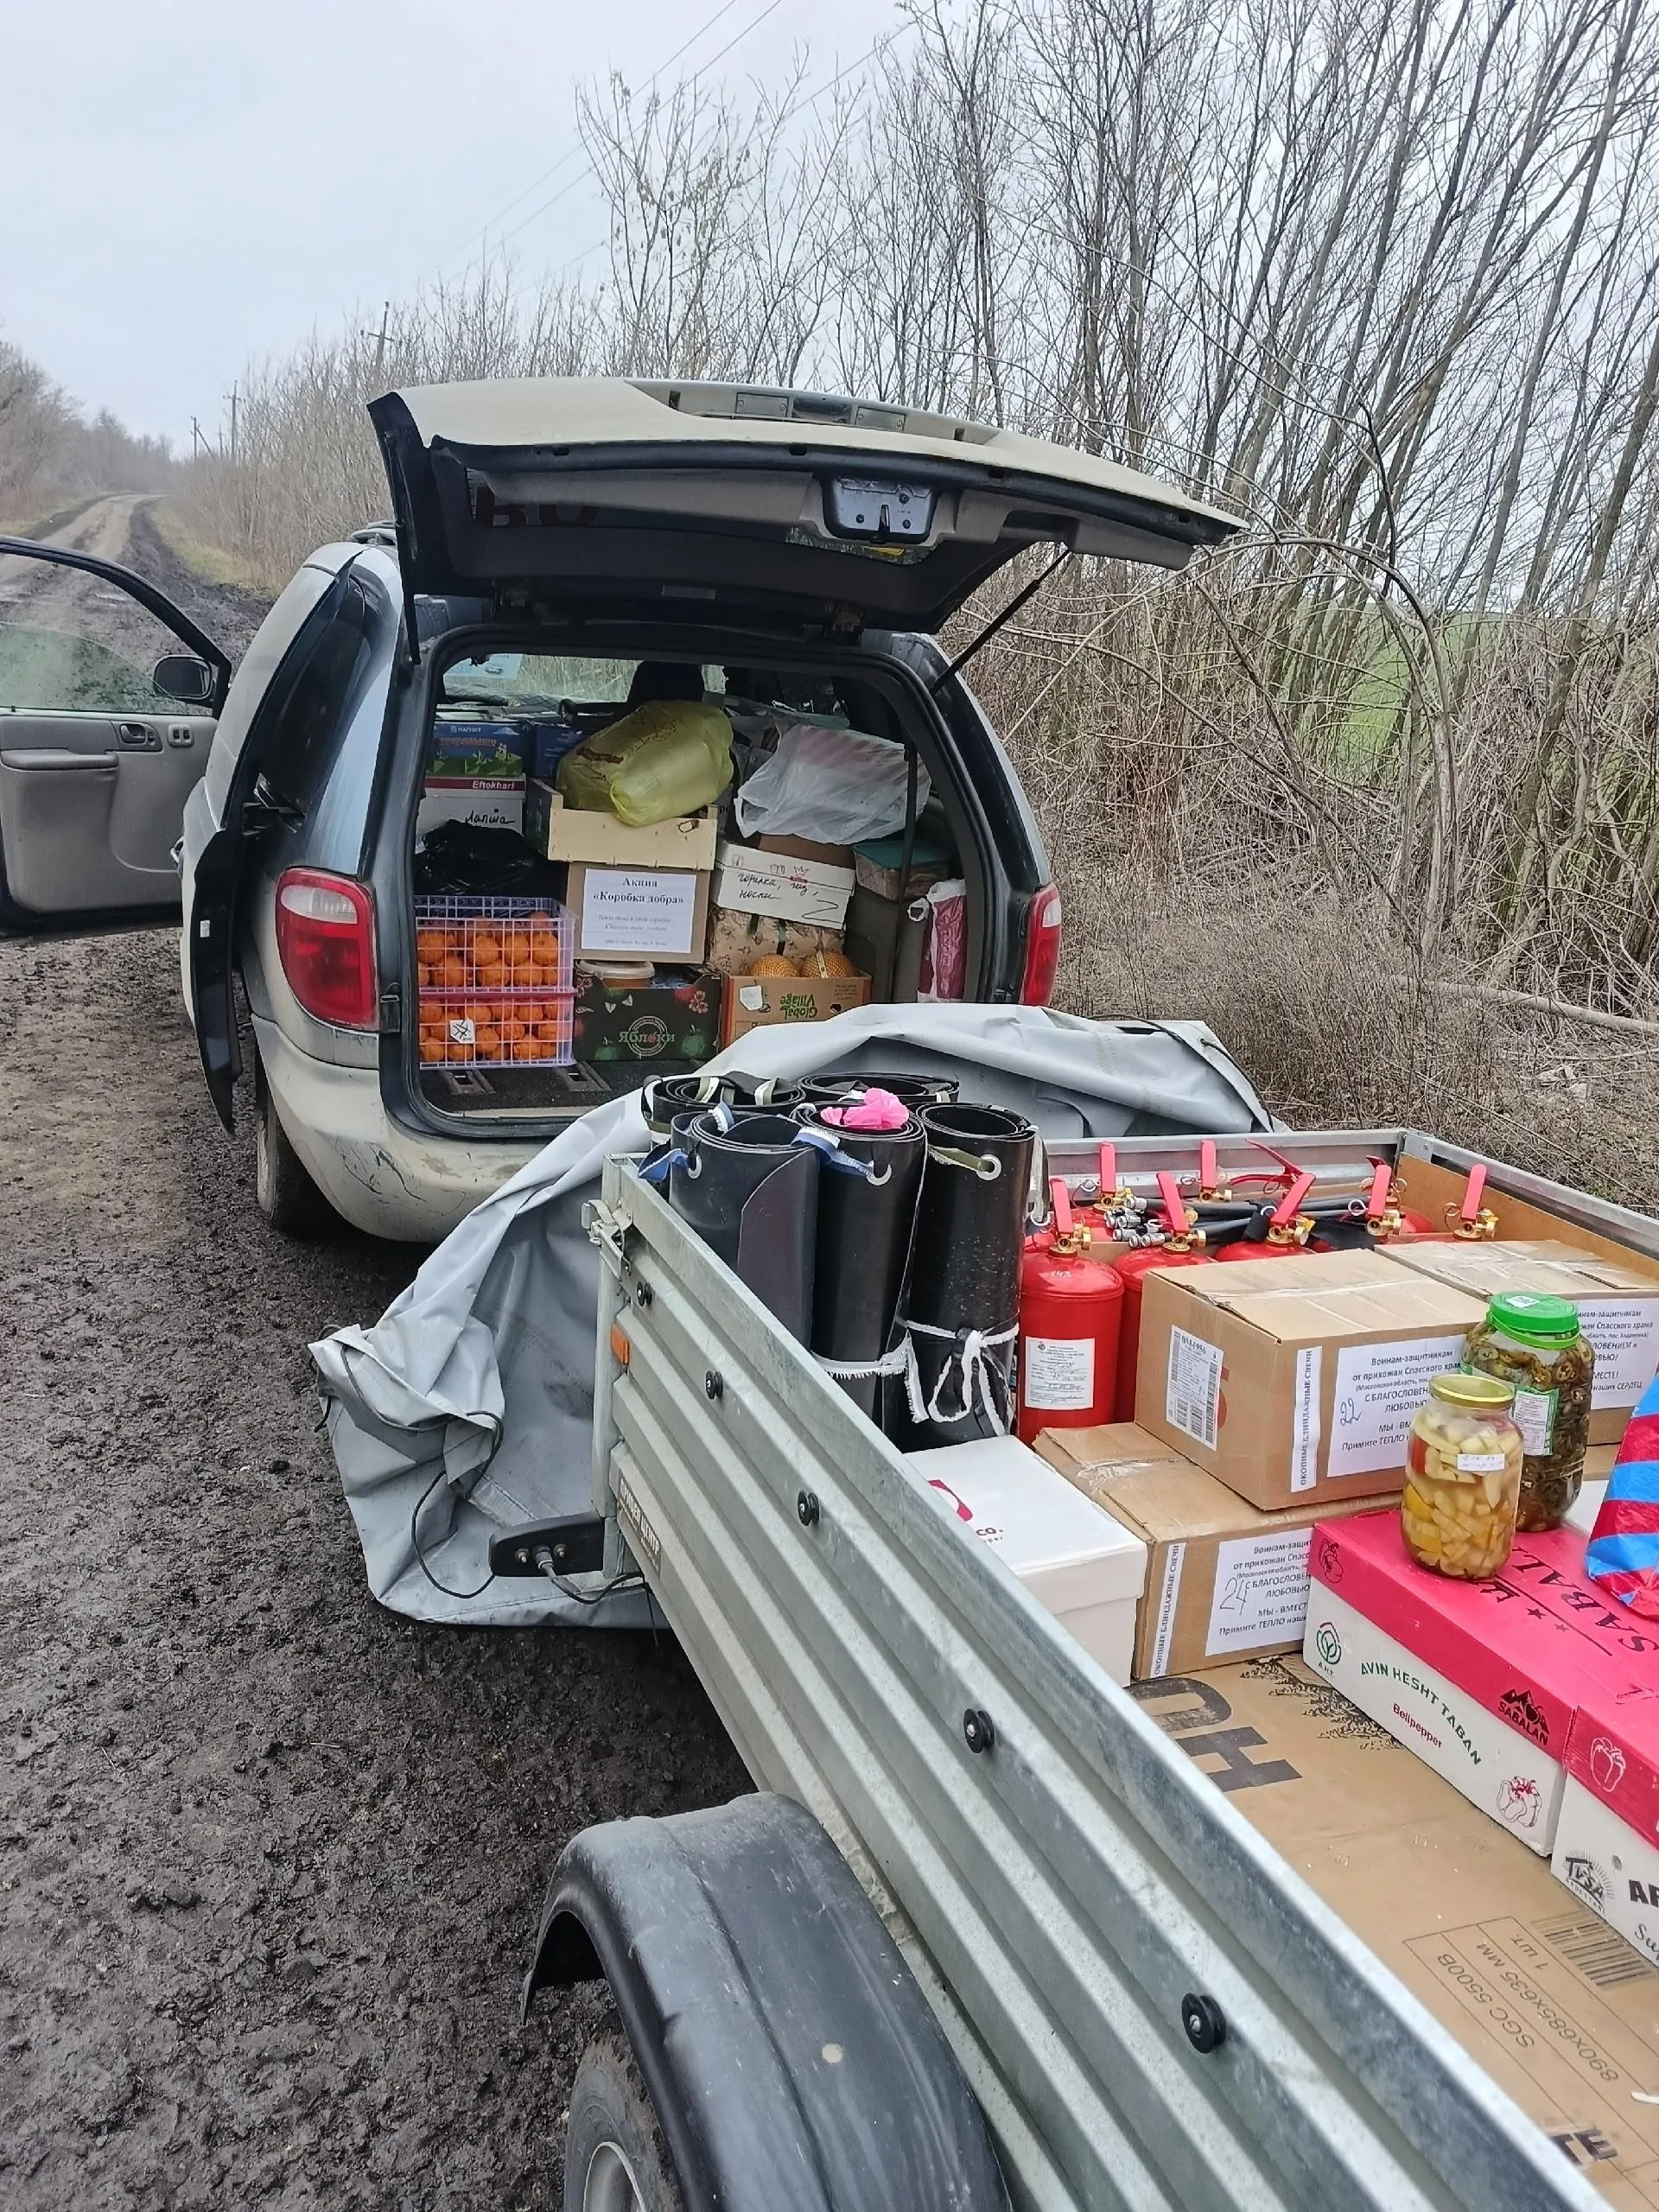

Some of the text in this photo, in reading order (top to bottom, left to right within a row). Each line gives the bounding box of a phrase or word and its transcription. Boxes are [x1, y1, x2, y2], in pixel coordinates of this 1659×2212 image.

[622, 877, 658, 888] Акция
[780, 993, 816, 1007] Village
[784, 1005, 818, 1020] Global
[1596, 1321, 1632, 1330] Спасского
[1370, 1350, 1453, 1366] Воинам-защитникам
[1352, 1373, 1363, 1382] от
[1363, 1368, 1403, 1382] прихожан
[1404, 1363, 1442, 1376] Спасского
[1617, 1382, 1643, 1390] СЕРДЕЦ
[1364, 1394, 1370, 1402] С
[1378, 1423, 1394, 1433] МЫ
[1341, 1439, 1378, 1452] Примите
[1379, 1434, 1405, 1446] ТЕПЛО
[1244, 1556, 1286, 1571] прихожан
[1219, 1577, 1248, 1617] 24
[1258, 1608, 1274, 1618] МЫ
[1219, 1624, 1256, 1637] Примите
[1258, 1618, 1286, 1629] ТЕПЛО
[1154, 1634, 1166, 1675] ОКОПНЫЕ
[1361, 1662, 1482, 1765] AVIN HESHT TABAN
[1393, 1702, 1443, 1749] Bellpepper
[1497, 1700, 1549, 1746] SABALAN
[1489, 2006, 1535, 2049] SGC
